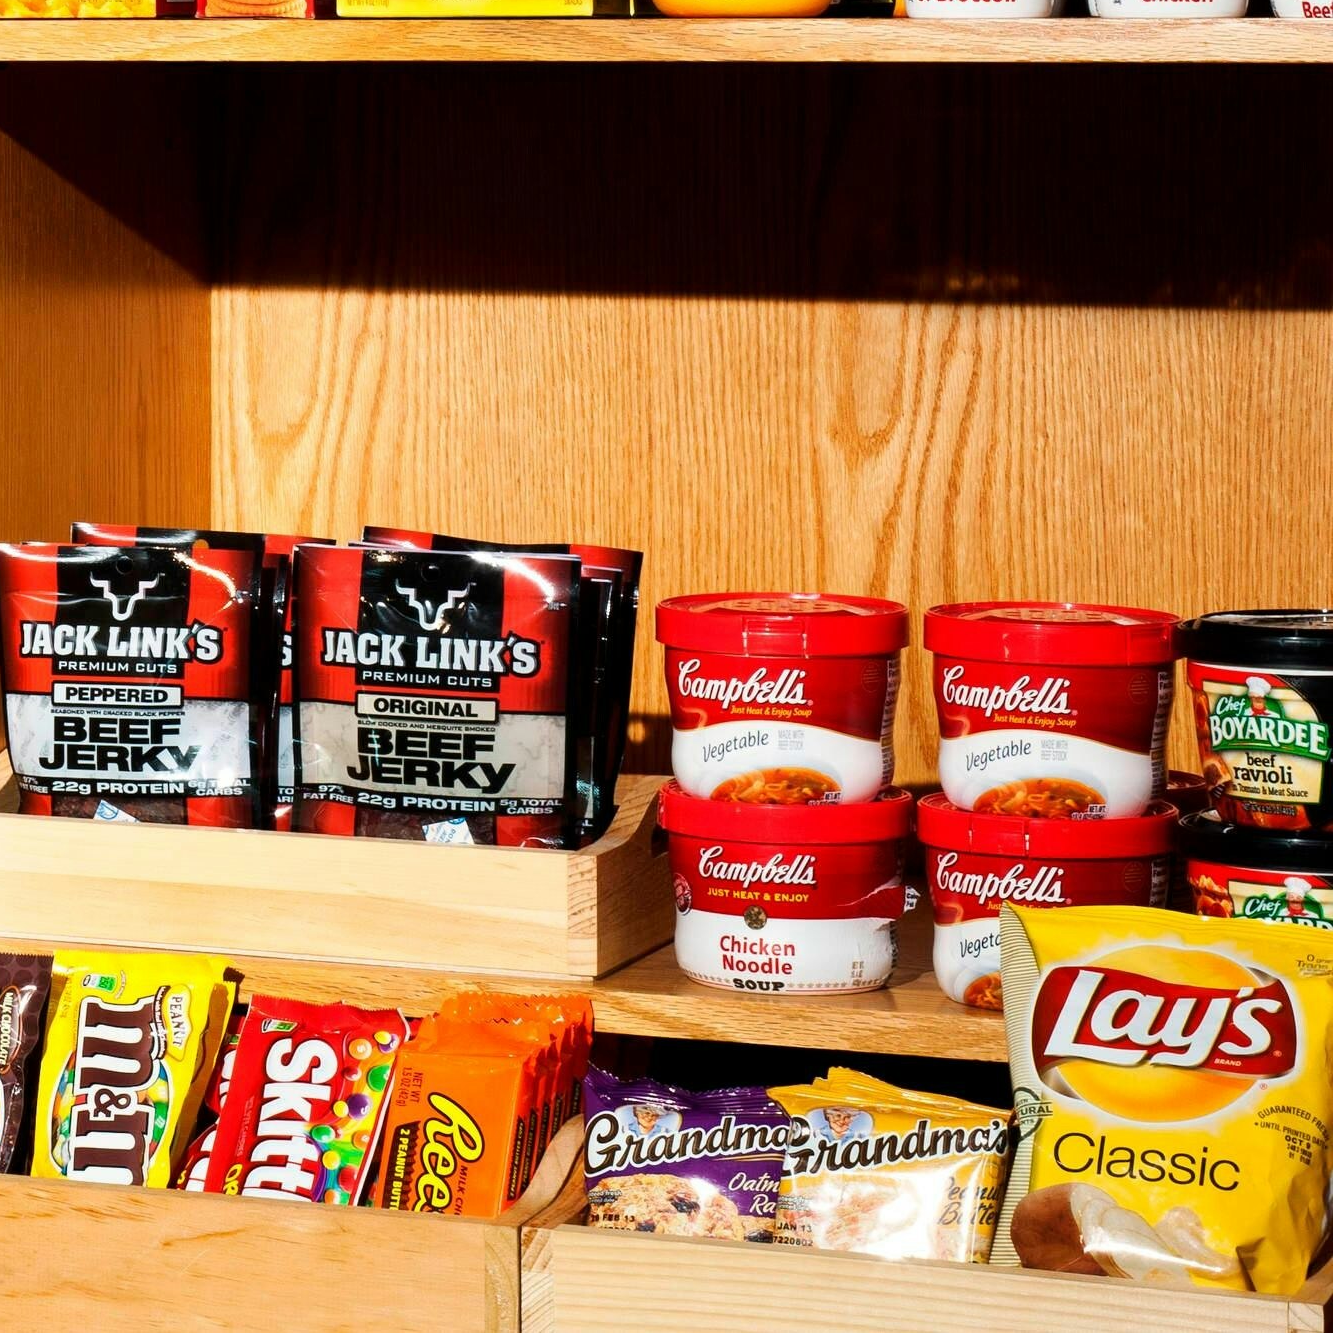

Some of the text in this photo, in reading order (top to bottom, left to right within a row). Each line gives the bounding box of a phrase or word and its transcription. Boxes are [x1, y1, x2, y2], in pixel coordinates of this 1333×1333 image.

[22, 623, 220, 661] JACK LINK'S
[325, 630, 537, 674] JACK LINK'S
[59, 661, 177, 674] PREMIUM CUTS
[362, 670, 492, 688] PREMIUM CUTS
[65, 686, 168, 703] PEPPERED
[373, 697, 478, 718] ORIGINAL
[53, 717, 181, 745] BEEF
[1210, 715, 1328, 756] BOYARDEE
[357, 727, 495, 760] BEEF
[702, 730, 769, 764] Vegetable
[38, 744, 205, 772] JERKY
[966, 740, 1032, 773] Vegetable
[1245, 752, 1276, 768] beef
[346, 755, 517, 795] JERKY
[1234, 766, 1293, 785] ravioli
[52, 780, 184, 794] 22g PROTEIN
[357, 793, 495, 812] 22g PROTEIN
[521, 799, 562, 807] TOTAL
[707, 887, 809, 903] JUST HEAT ENJOY
[719, 935, 796, 957] Chicken
[721, 953, 793, 976] Noodle
[732, 978, 785, 992] SOUP
[170, 995, 185, 1047] PEANUT
[1043, 969, 1283, 1068] Lay's
[1214, 1058, 1241, 1066] BRAND
[1285, 1136, 1304, 1144] OCT
[395, 1138, 409, 1174] PEANUT
[1053, 1132, 1241, 1191] Classic
[777, 1222, 797, 1232] JAN
